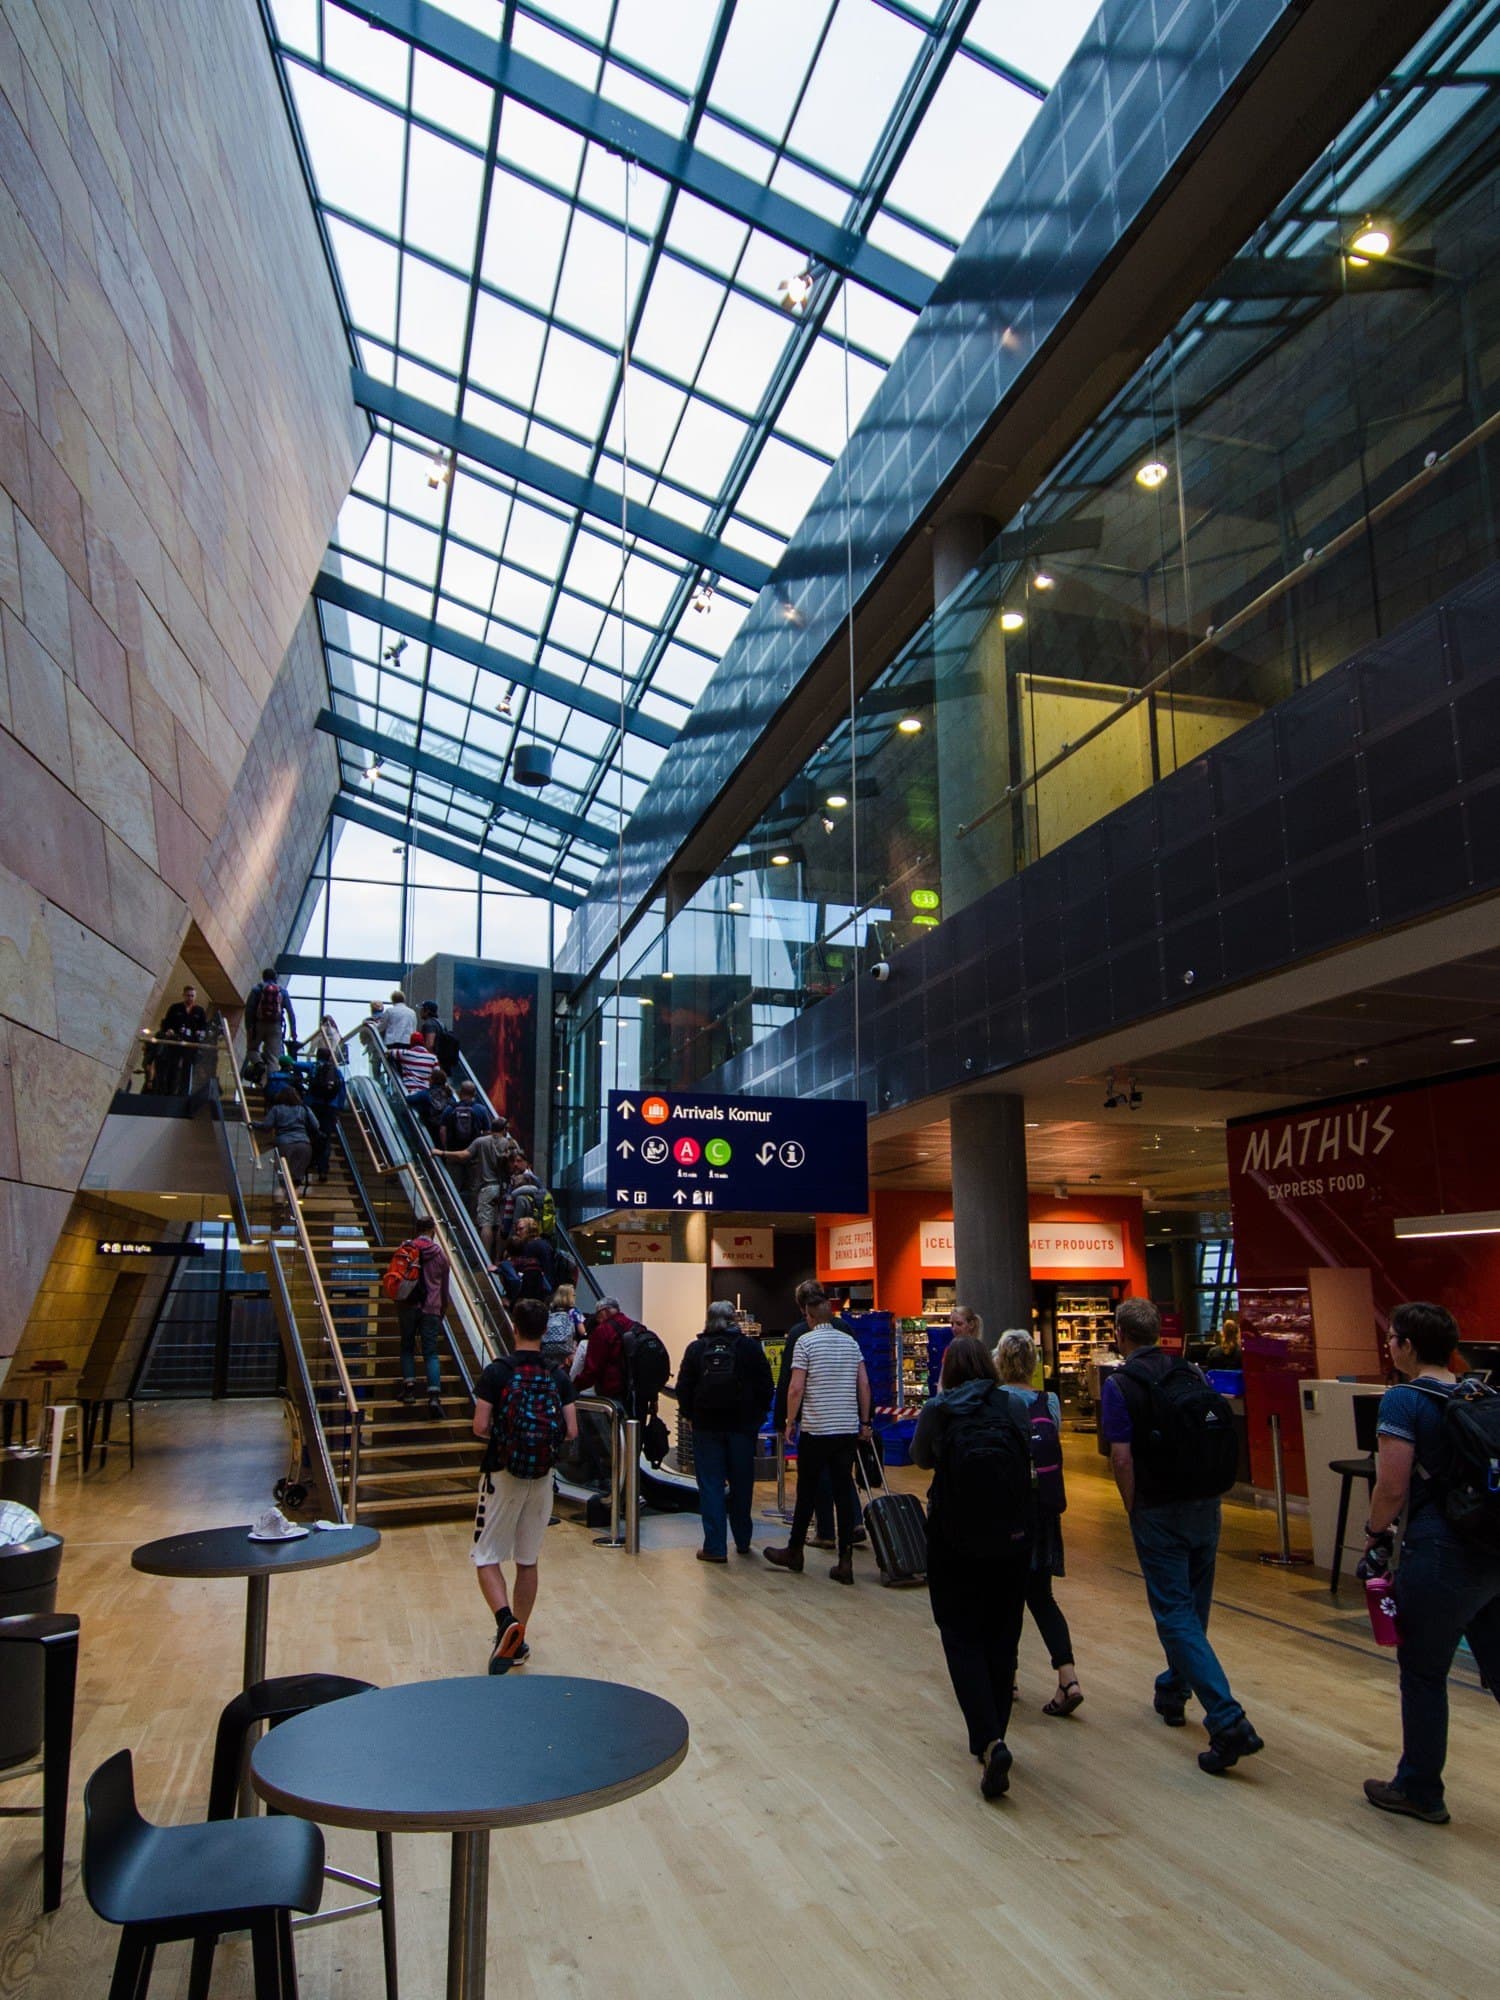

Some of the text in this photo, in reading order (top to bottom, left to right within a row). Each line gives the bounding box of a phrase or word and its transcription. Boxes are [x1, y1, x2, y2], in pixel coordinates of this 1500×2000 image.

[672, 1104, 772, 1122] Arrivals Komur
[1241, 1104, 1395, 1174] MATHÚS
[680, 1141, 724, 1158] A C
[1268, 1174, 1366, 1200] EXPRESS FOOD
[859, 1247, 872, 1257] SNAC
[926, 1238, 1115, 1250] ICEL MET PRODUCTS
